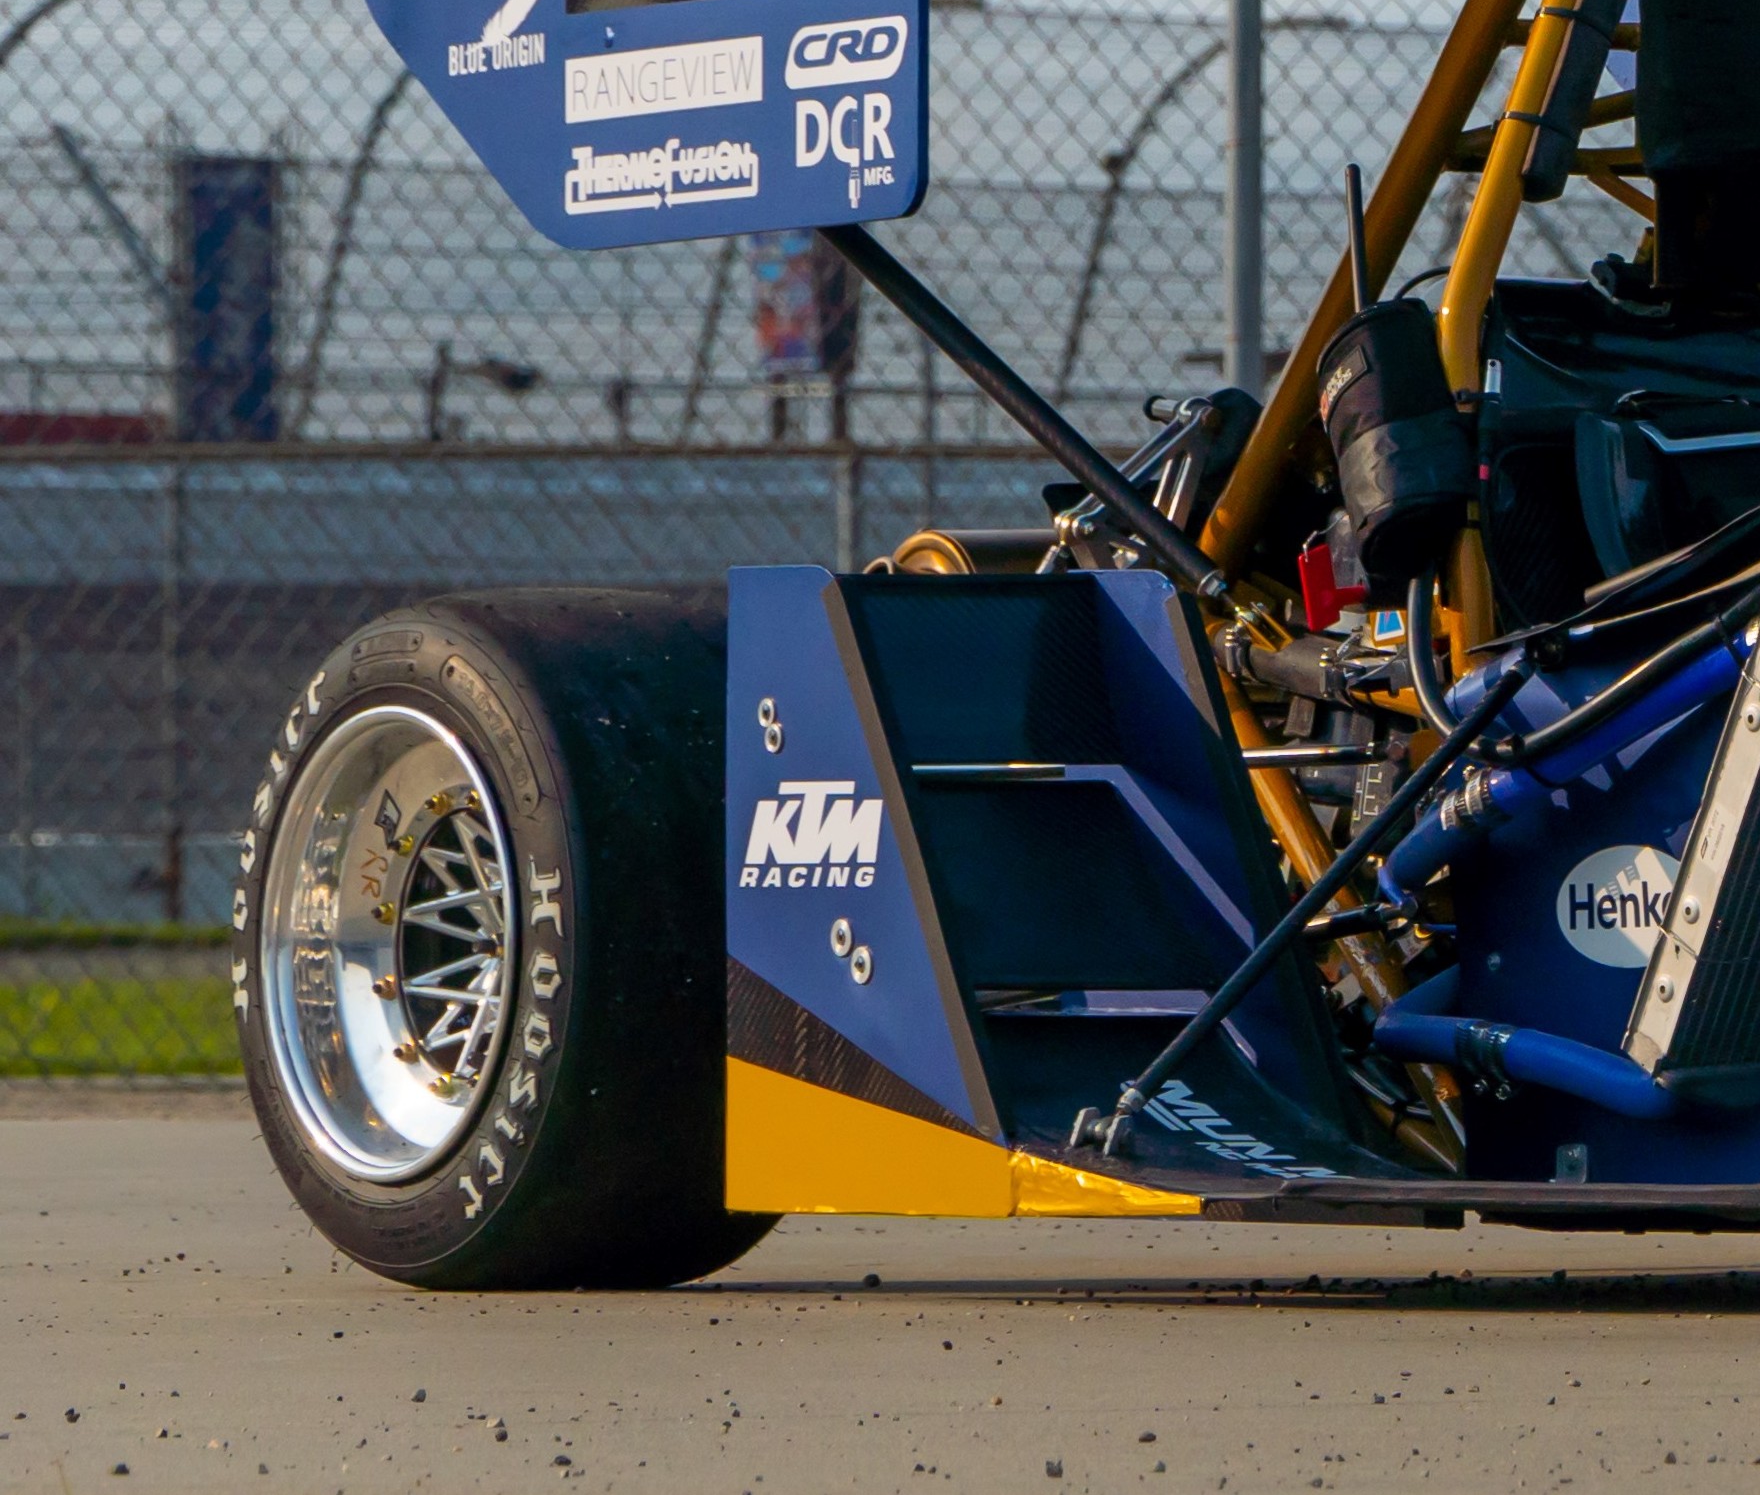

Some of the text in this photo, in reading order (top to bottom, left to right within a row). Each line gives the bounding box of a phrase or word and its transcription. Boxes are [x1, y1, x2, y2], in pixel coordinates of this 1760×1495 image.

[448, 32, 546, 77] BLUE ORIGIN
[793, 25, 900, 66] CRD
[572, 49, 755, 112] RANGEVIEW
[795, 93, 894, 167] DCR
[744, 780, 883, 865] KTM
[739, 866, 876, 889] RACING
[460, 854, 567, 1220] Hoosier
